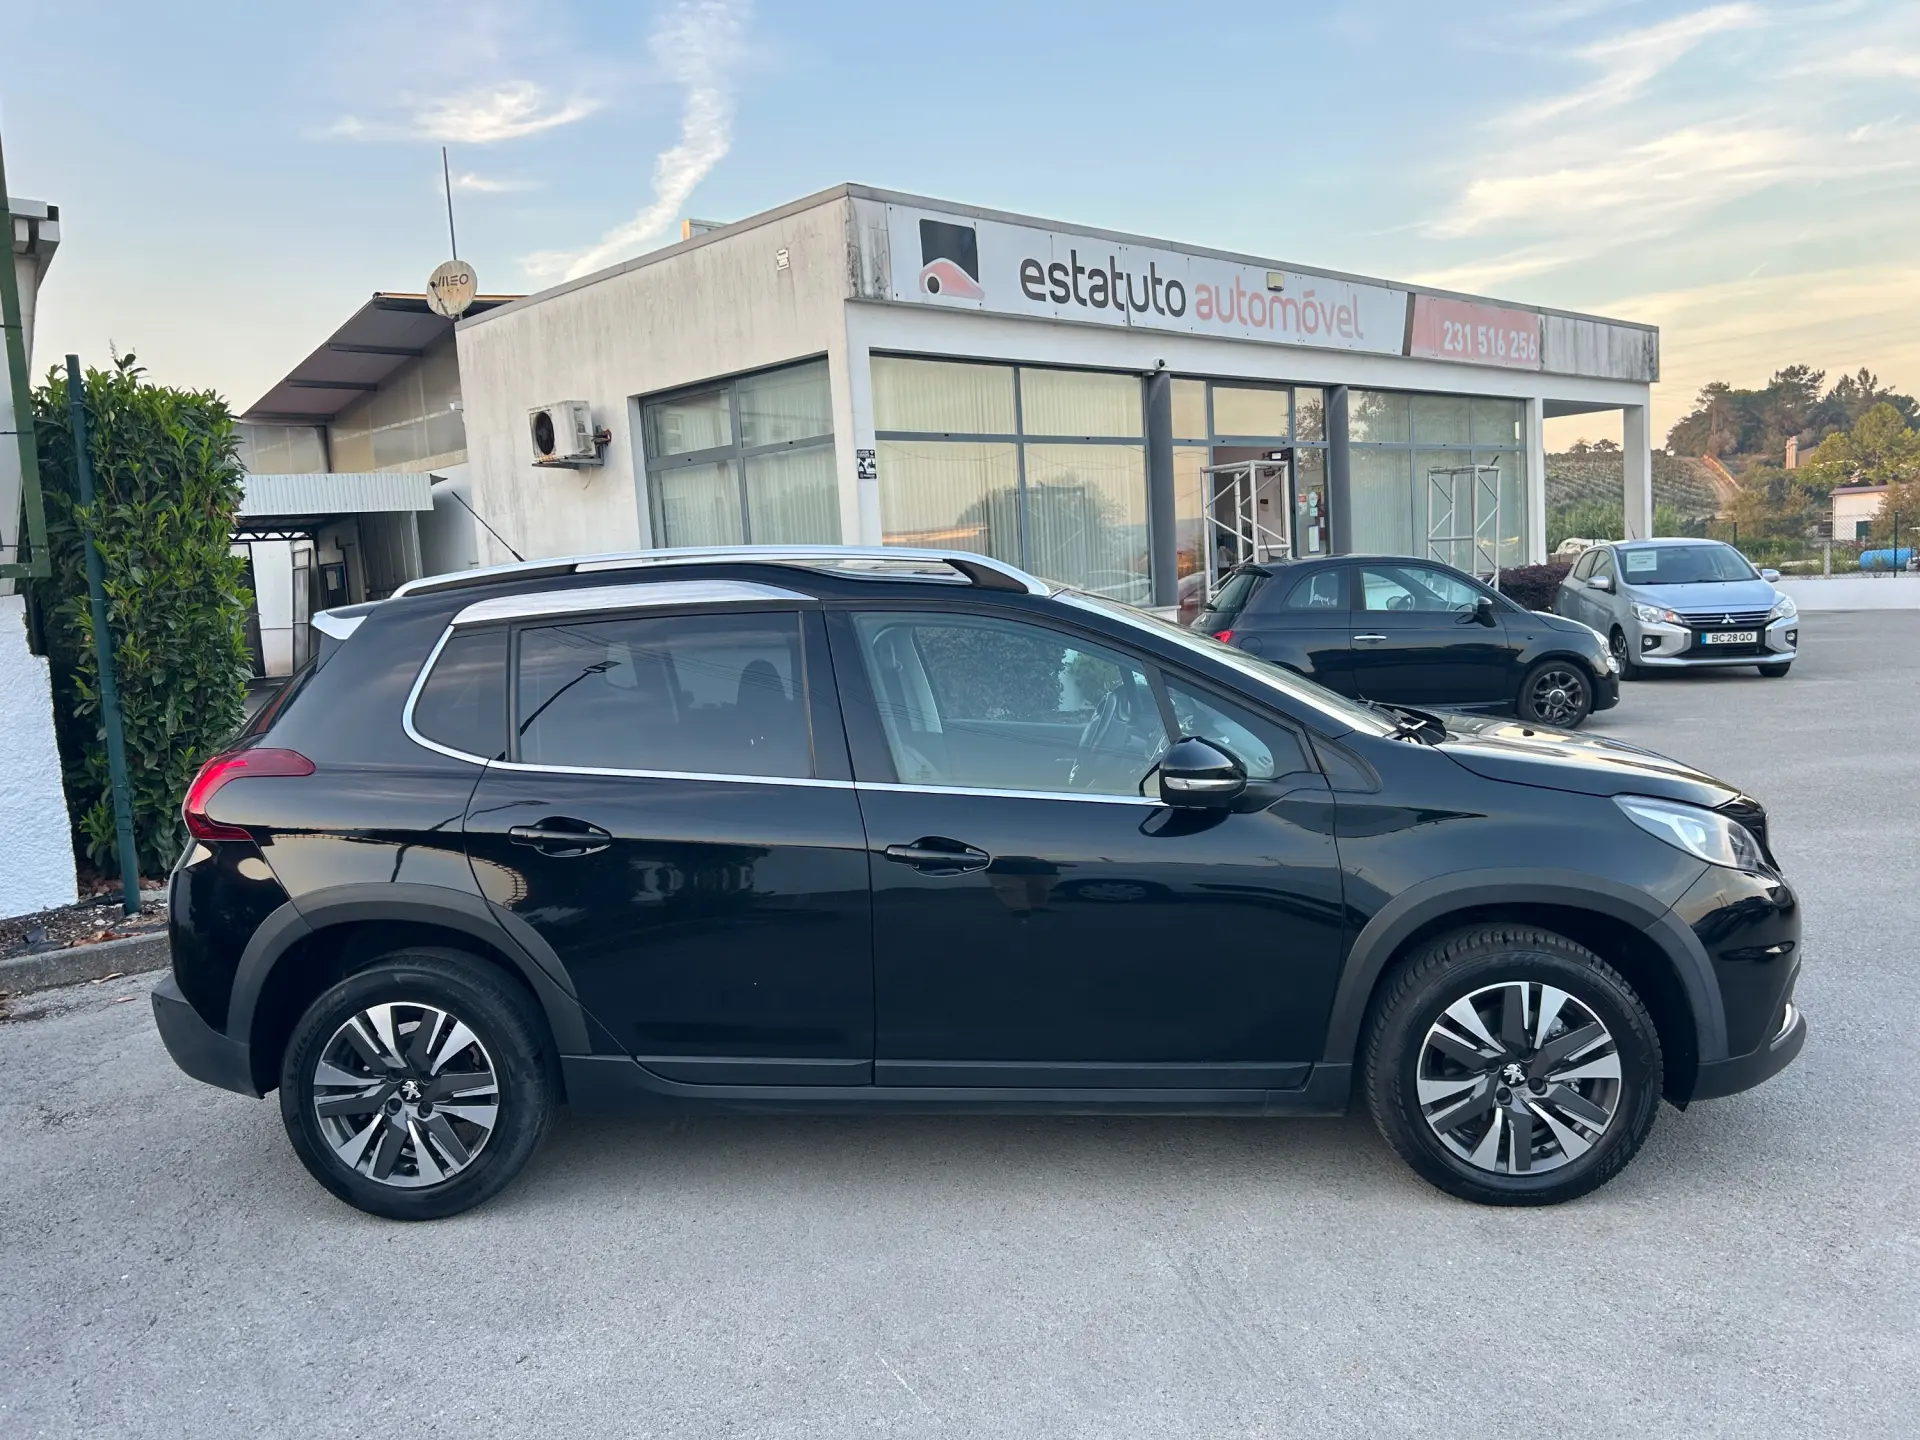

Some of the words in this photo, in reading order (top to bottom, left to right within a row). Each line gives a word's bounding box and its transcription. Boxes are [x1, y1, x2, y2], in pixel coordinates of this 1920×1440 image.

[438, 273, 469, 287] MEO
[1019, 248, 1187, 318] estatuto
[1194, 274, 1364, 340] automóvel
[1443, 320, 1472, 353] 231
[1476, 325, 1506, 356] 516
[1509, 330, 1537, 361] 256
